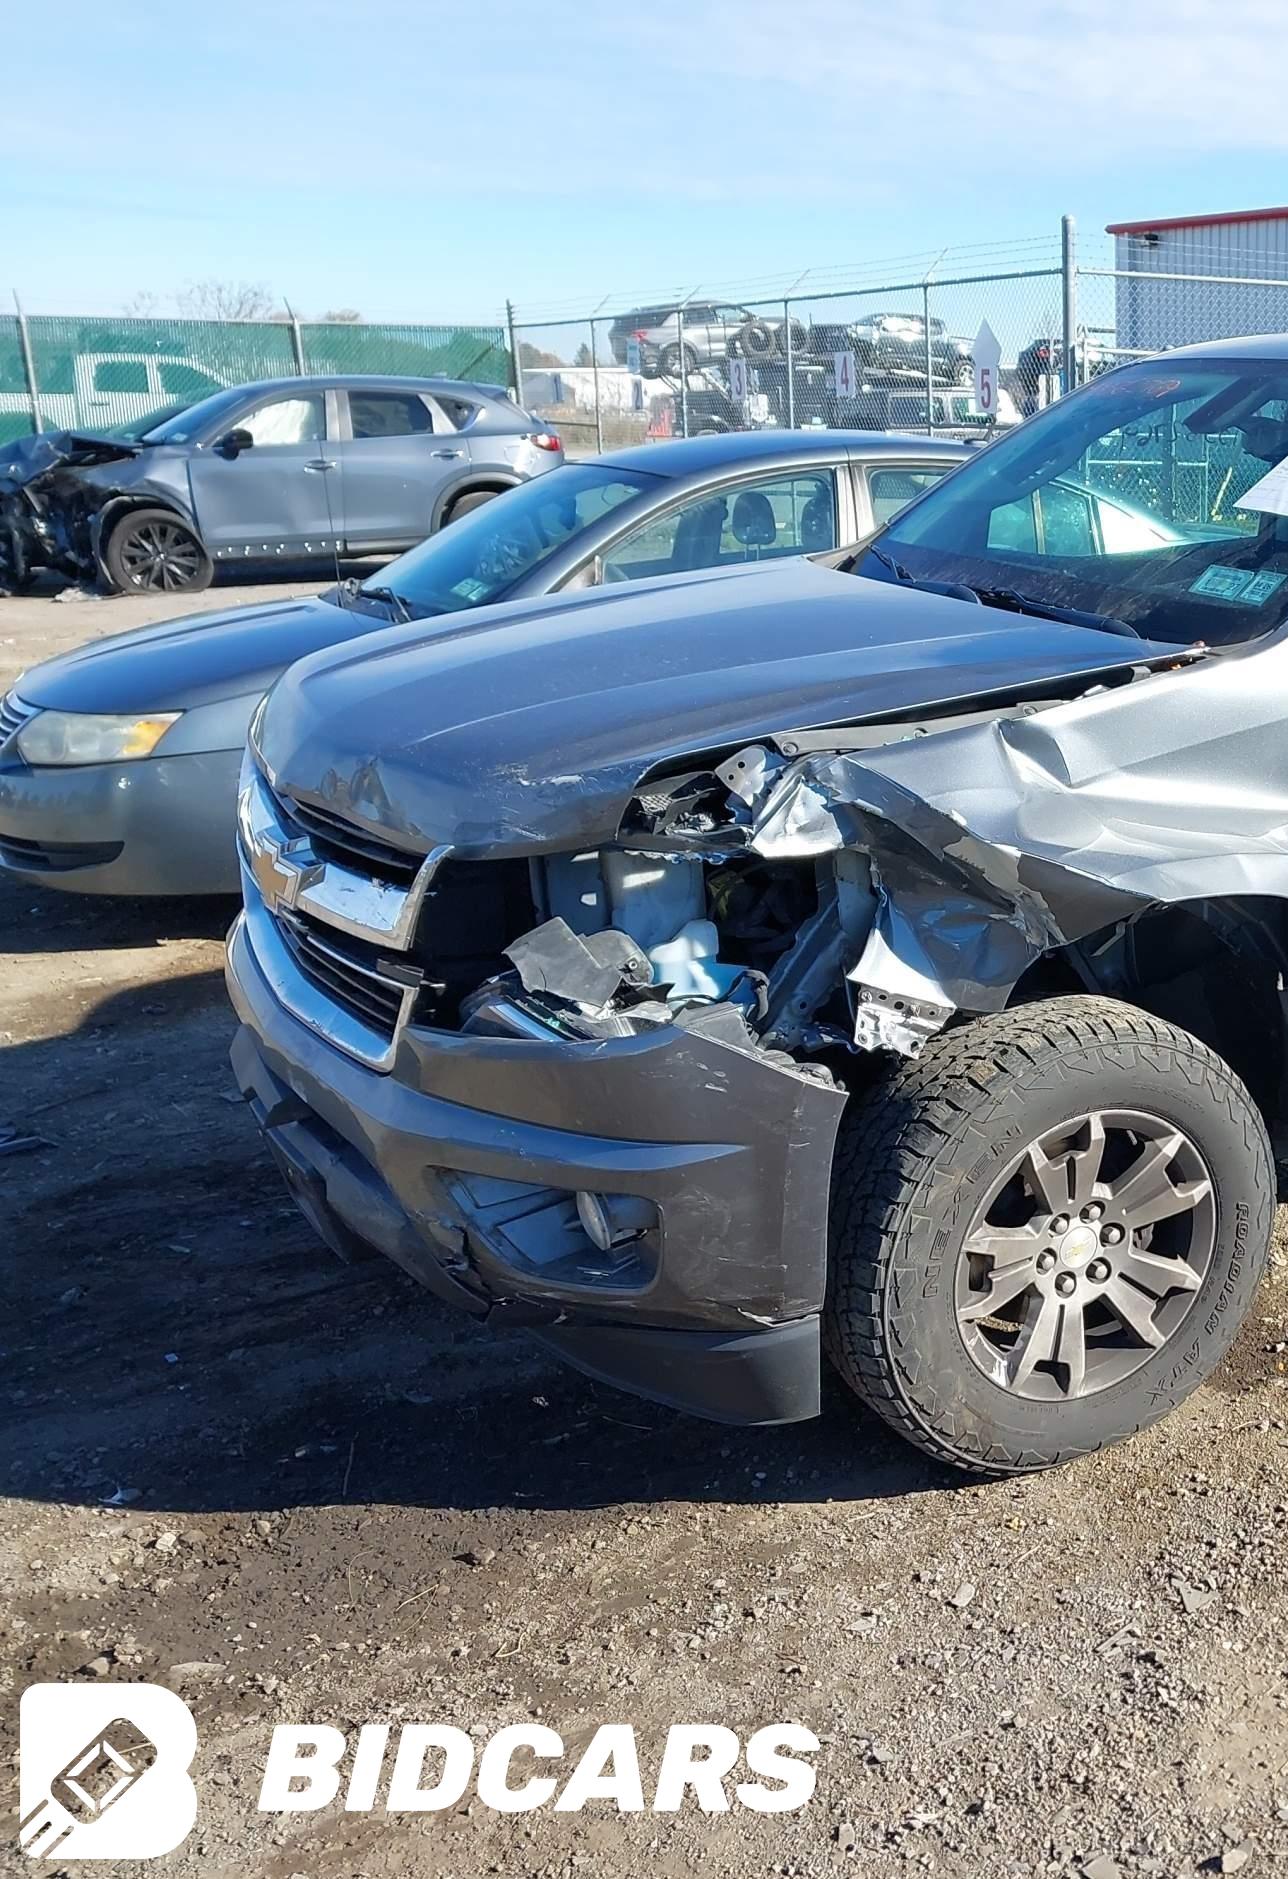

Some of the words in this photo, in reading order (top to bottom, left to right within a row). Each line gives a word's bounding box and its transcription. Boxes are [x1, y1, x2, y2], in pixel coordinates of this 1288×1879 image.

[734, 363, 743, 396] 3
[840, 355, 850, 393] 4
[980, 368, 991, 409] 5
[922, 1125, 1024, 1298] NEXEN
[1204, 1202, 1249, 1335] ROADIAN
